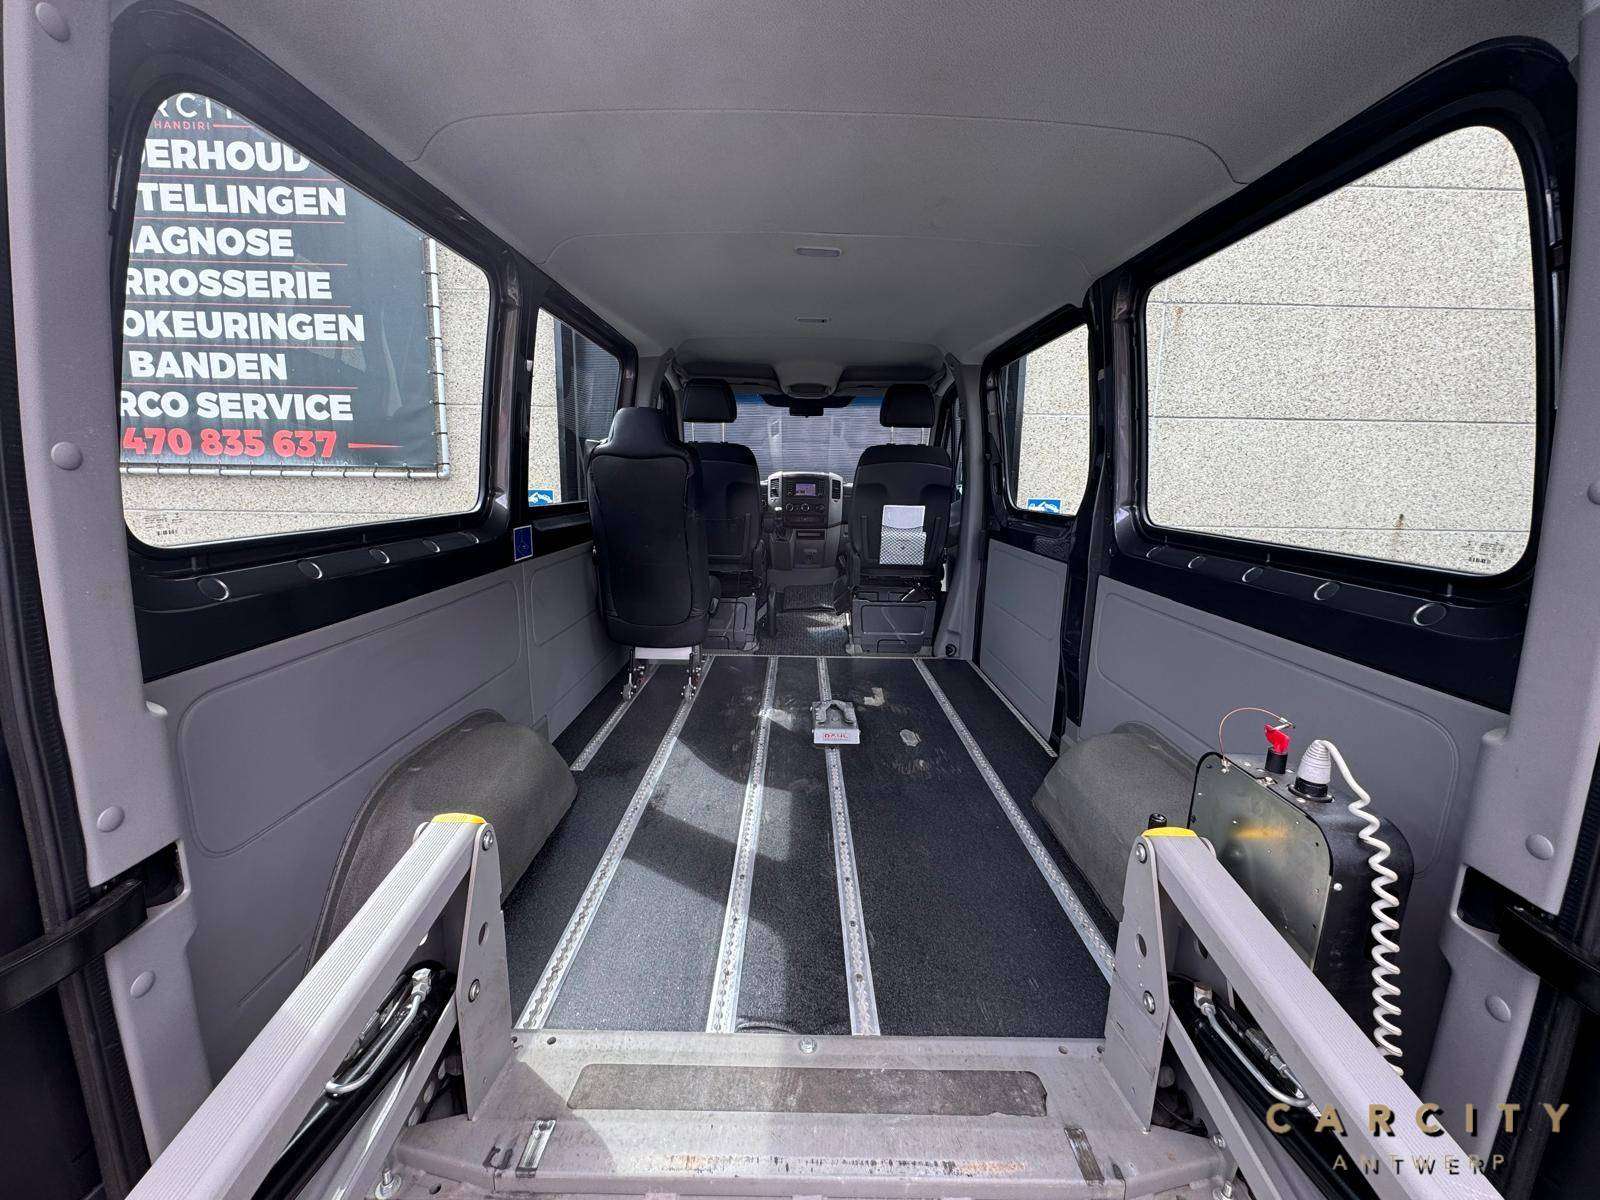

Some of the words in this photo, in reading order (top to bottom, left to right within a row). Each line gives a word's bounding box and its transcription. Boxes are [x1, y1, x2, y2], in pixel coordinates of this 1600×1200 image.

[141, 138, 310, 172] ERHOUD
[137, 182, 347, 216] TELLINGEN
[125, 267, 333, 299] RROSSERIE
[123, 309, 365, 342] OKEURINGEN
[128, 350, 288, 381] BANDEN
[120, 391, 189, 418] RCO
[197, 392, 354, 421] SERVICE
[122, 427, 192, 456] 470
[200, 429, 265, 457] 835
[272, 430, 338, 458] 637
